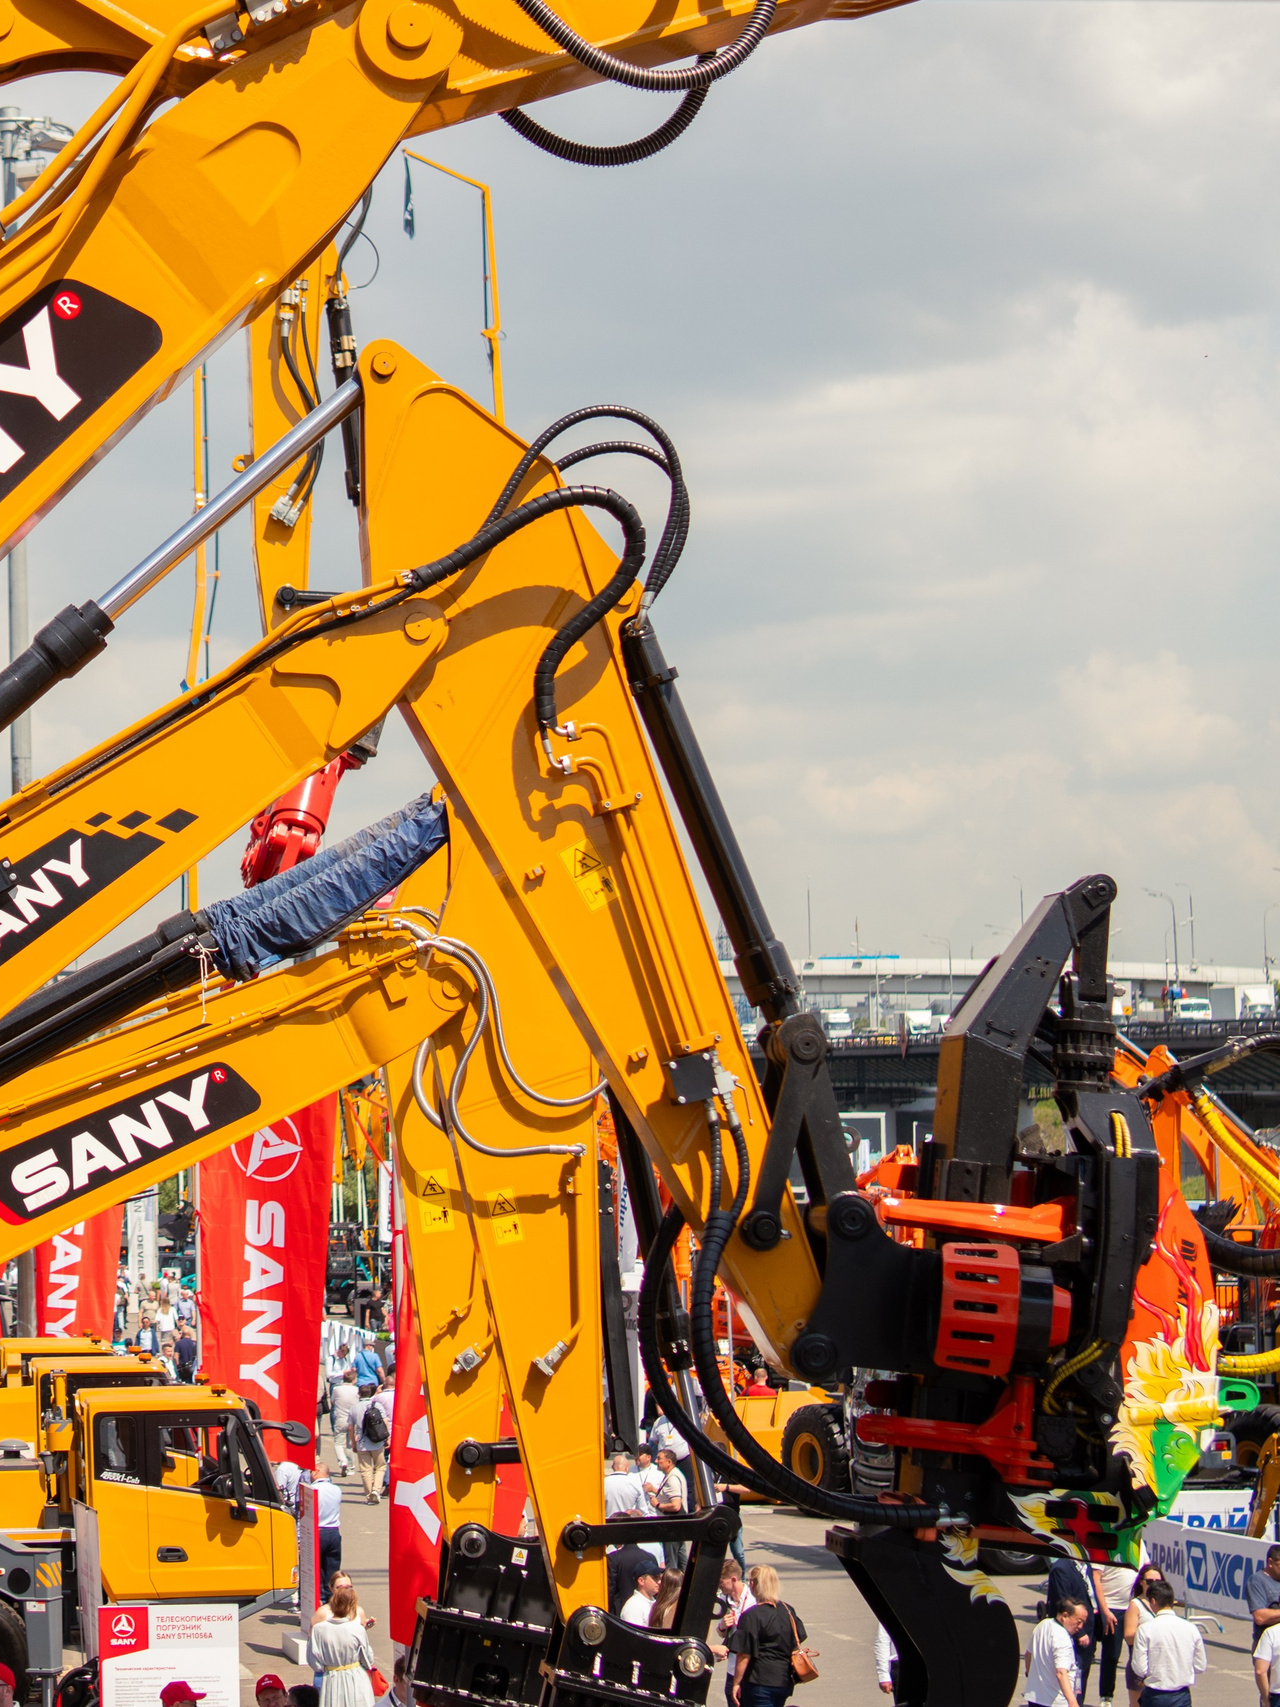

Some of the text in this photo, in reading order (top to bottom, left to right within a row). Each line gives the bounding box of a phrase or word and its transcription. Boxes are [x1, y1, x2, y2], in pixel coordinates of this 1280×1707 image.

[10, 1072, 210, 1213] SANY
[240, 1199, 286, 1399] SANY
[110, 1638, 137, 1646] SANY
[156, 1613, 233, 1623] ТЕЛЕСКОПИЧЕСКИЙ
